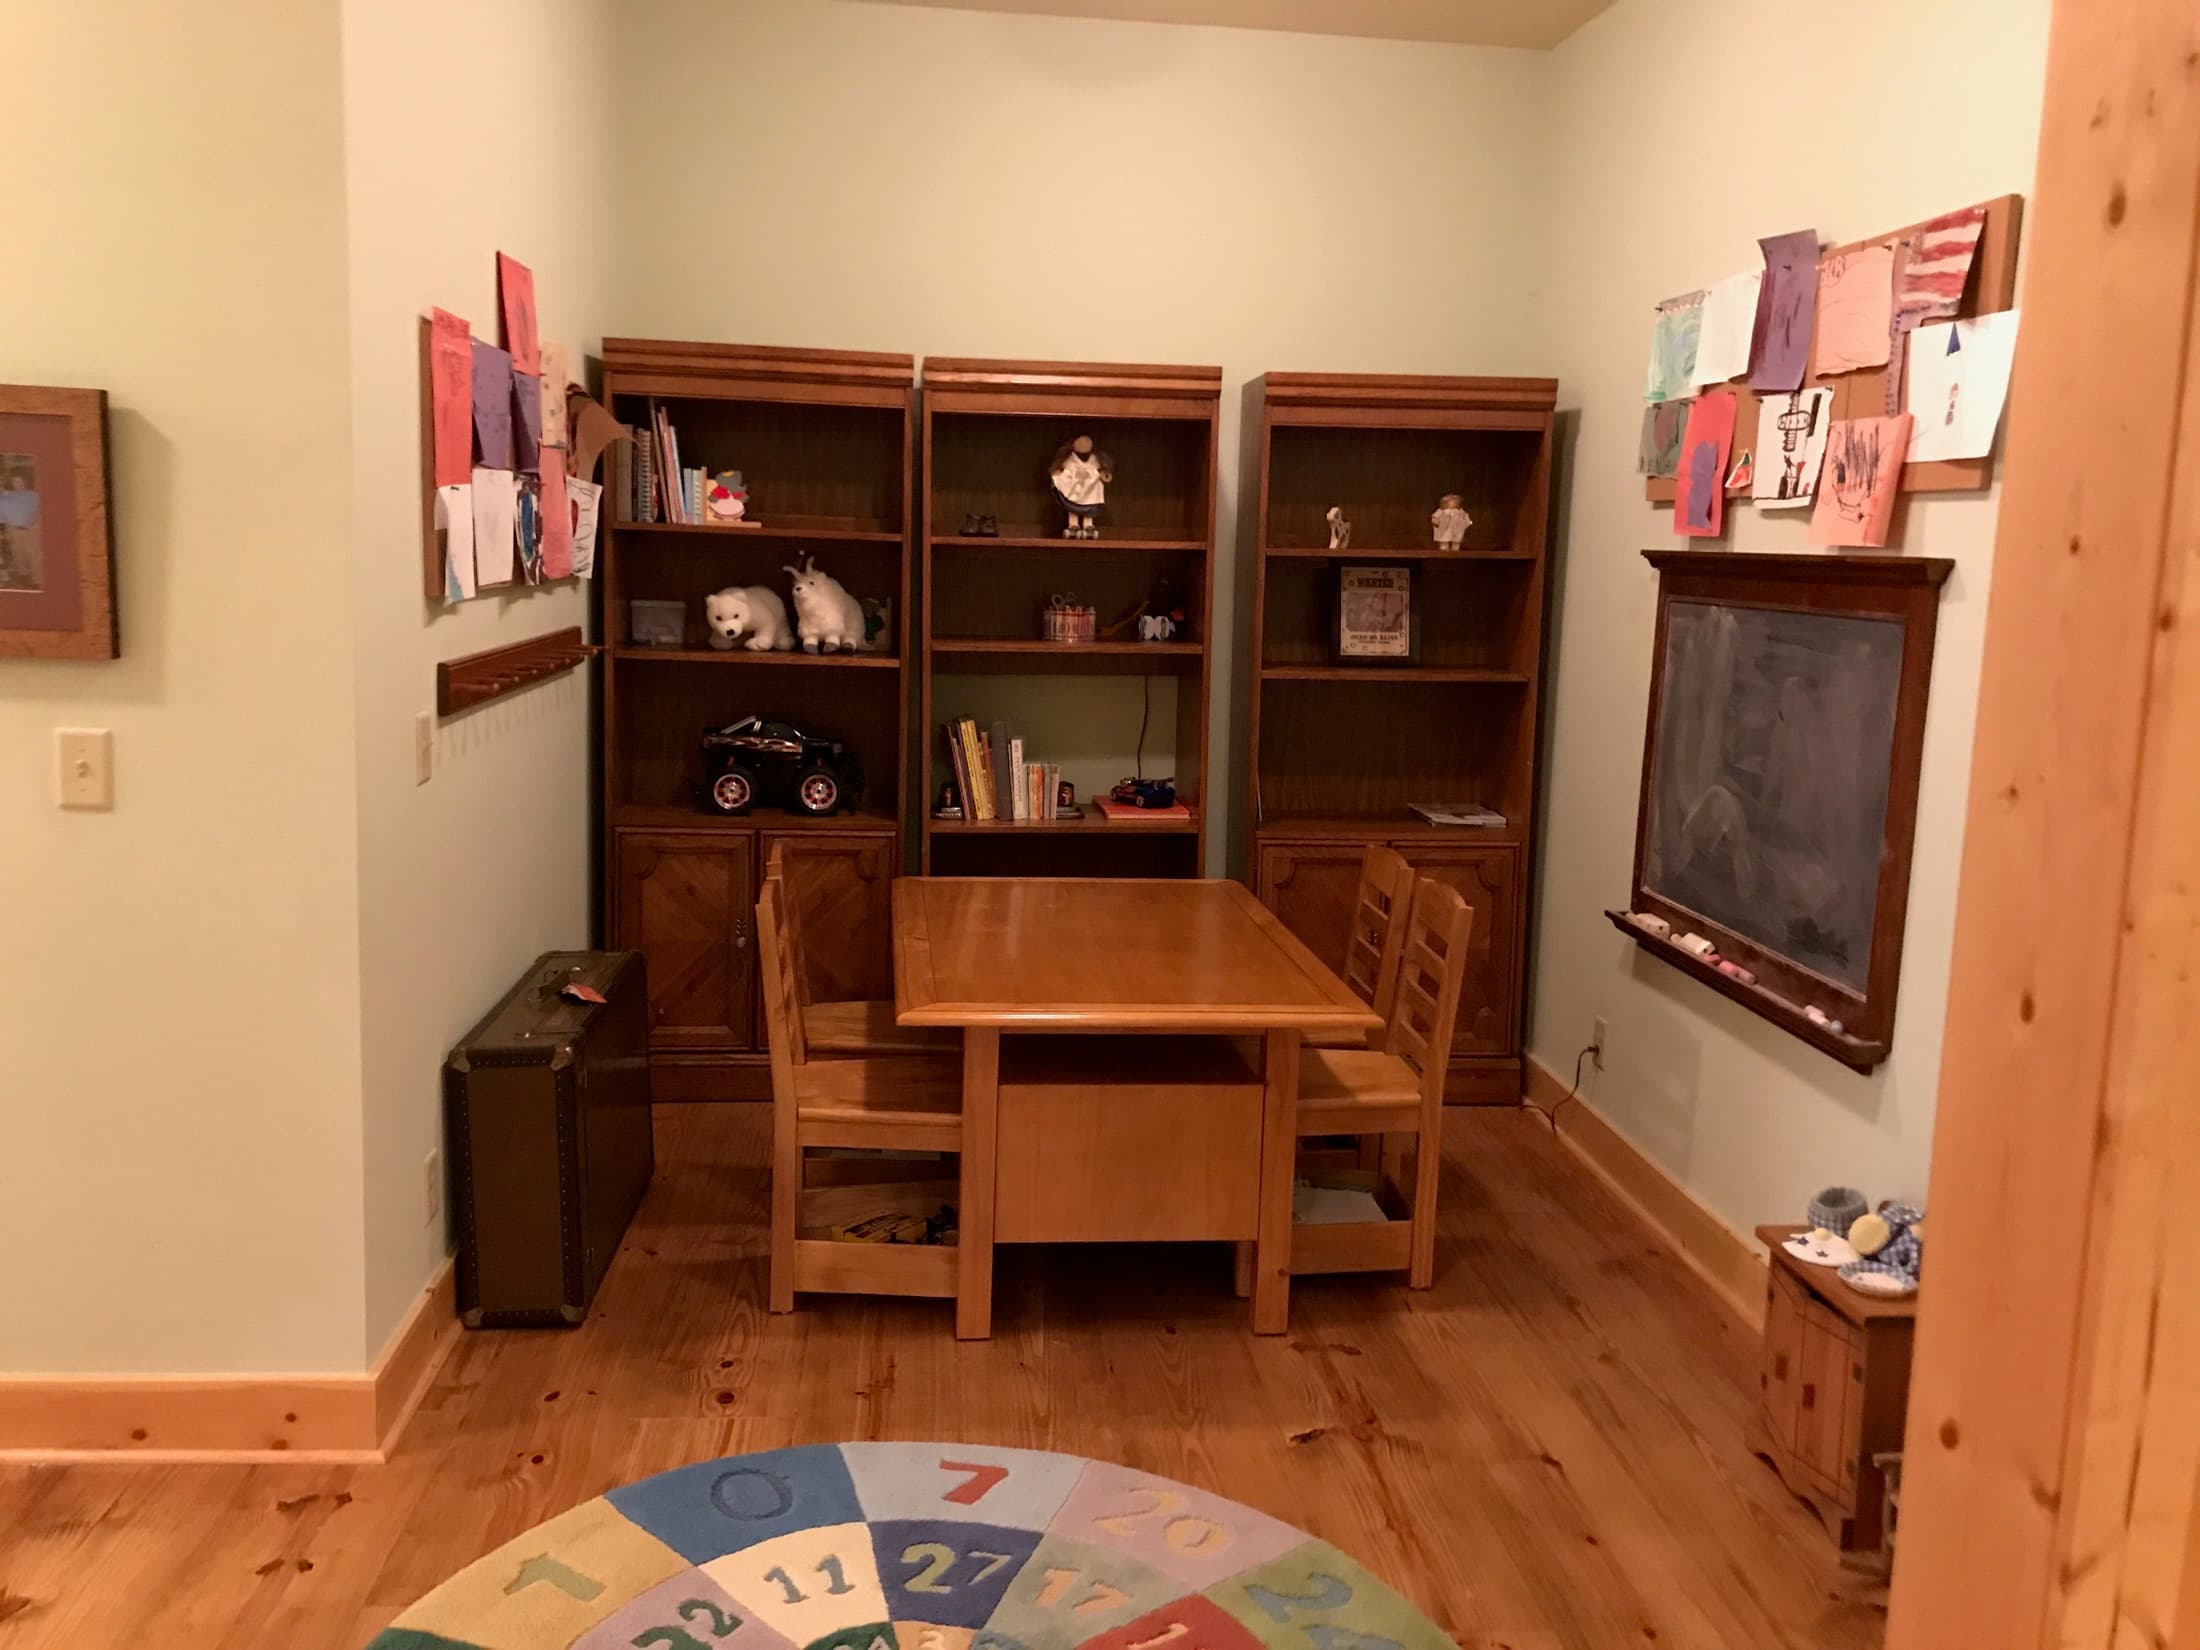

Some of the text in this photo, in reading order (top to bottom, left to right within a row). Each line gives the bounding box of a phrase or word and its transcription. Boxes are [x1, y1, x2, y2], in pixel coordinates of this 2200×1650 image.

[709, 1467, 794, 1522] 0
[939, 1457, 1009, 1505] 7
[1093, 1486, 1234, 1556] 20
[763, 1553, 858, 1605] 11
[901, 1542, 1014, 1595] 27
[1034, 1567, 1132, 1617] 17
